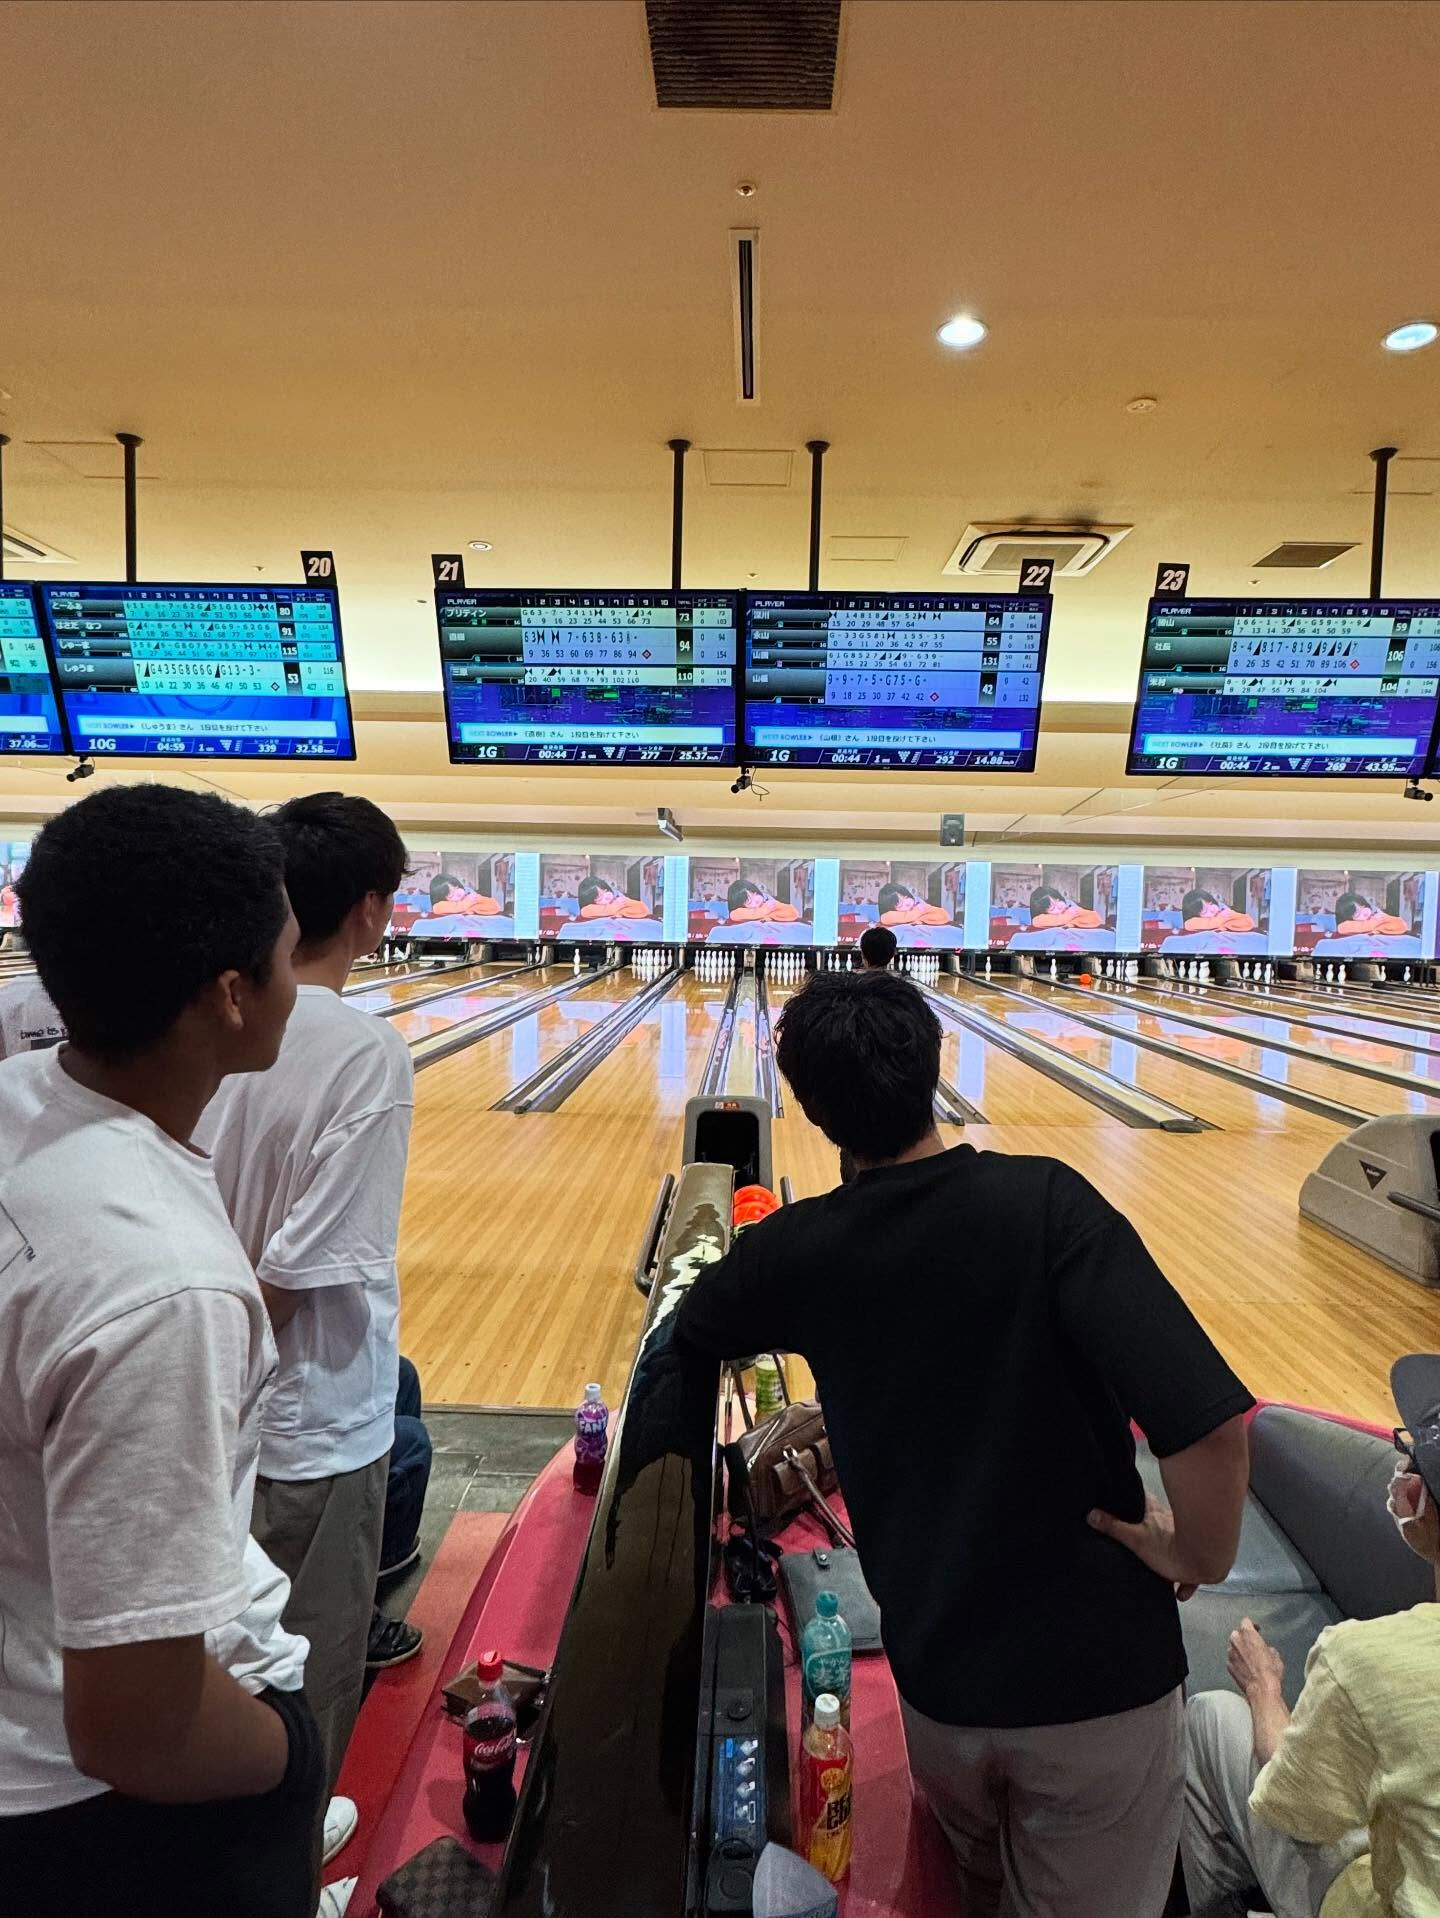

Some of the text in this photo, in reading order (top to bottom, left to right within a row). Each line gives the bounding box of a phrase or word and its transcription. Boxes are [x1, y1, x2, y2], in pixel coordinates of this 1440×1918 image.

[307, 557, 331, 577] 20
[439, 561, 459, 581] 21
[1022, 566, 1050, 586] 22
[1158, 570, 1185, 590] 23
[679, 613, 689, 621] 73
[988, 617, 999, 625] 64
[1396, 623, 1407, 631] 59
[679, 641, 690, 651] 94
[282, 647, 297, 655] 115
[585, 650, 593, 658] 69
[599, 650, 607, 658] 77
[614, 650, 622, 658] 86
[628, 650, 636, 658] 94
[1387, 651, 1404, 661] 106
[983, 657, 998, 666] 131
[1276, 660, 1284, 668] 42
[1290, 660, 1298, 668] 51
[1306, 660, 1314, 668] 70
[1321, 660, 1329, 668] 89
[1333, 660, 1346, 668] 106
[287, 674, 299, 684] 53
[982, 685, 993, 695] 42
[1382, 683, 1397, 691] 104
[858, 692, 866, 700] 25
[873, 692, 880, 700] 30
[887, 692, 895, 700] 37
[916, 693, 924, 701] 42
[89, 739, 116, 750] 10G
[157, 743, 185, 751] 04:59
[258, 744, 276, 752] 339
[478, 746, 497, 757] 1G
[539, 751, 567, 759] 00:44
[770, 750, 790, 761] 1G
[832, 754, 860, 763] 00:44
[935, 756, 955, 764] 292
[1156, 757, 1178, 769] 1G
[1220, 761, 1250, 770] 00:44
[1325, 763, 1346, 771] 269
